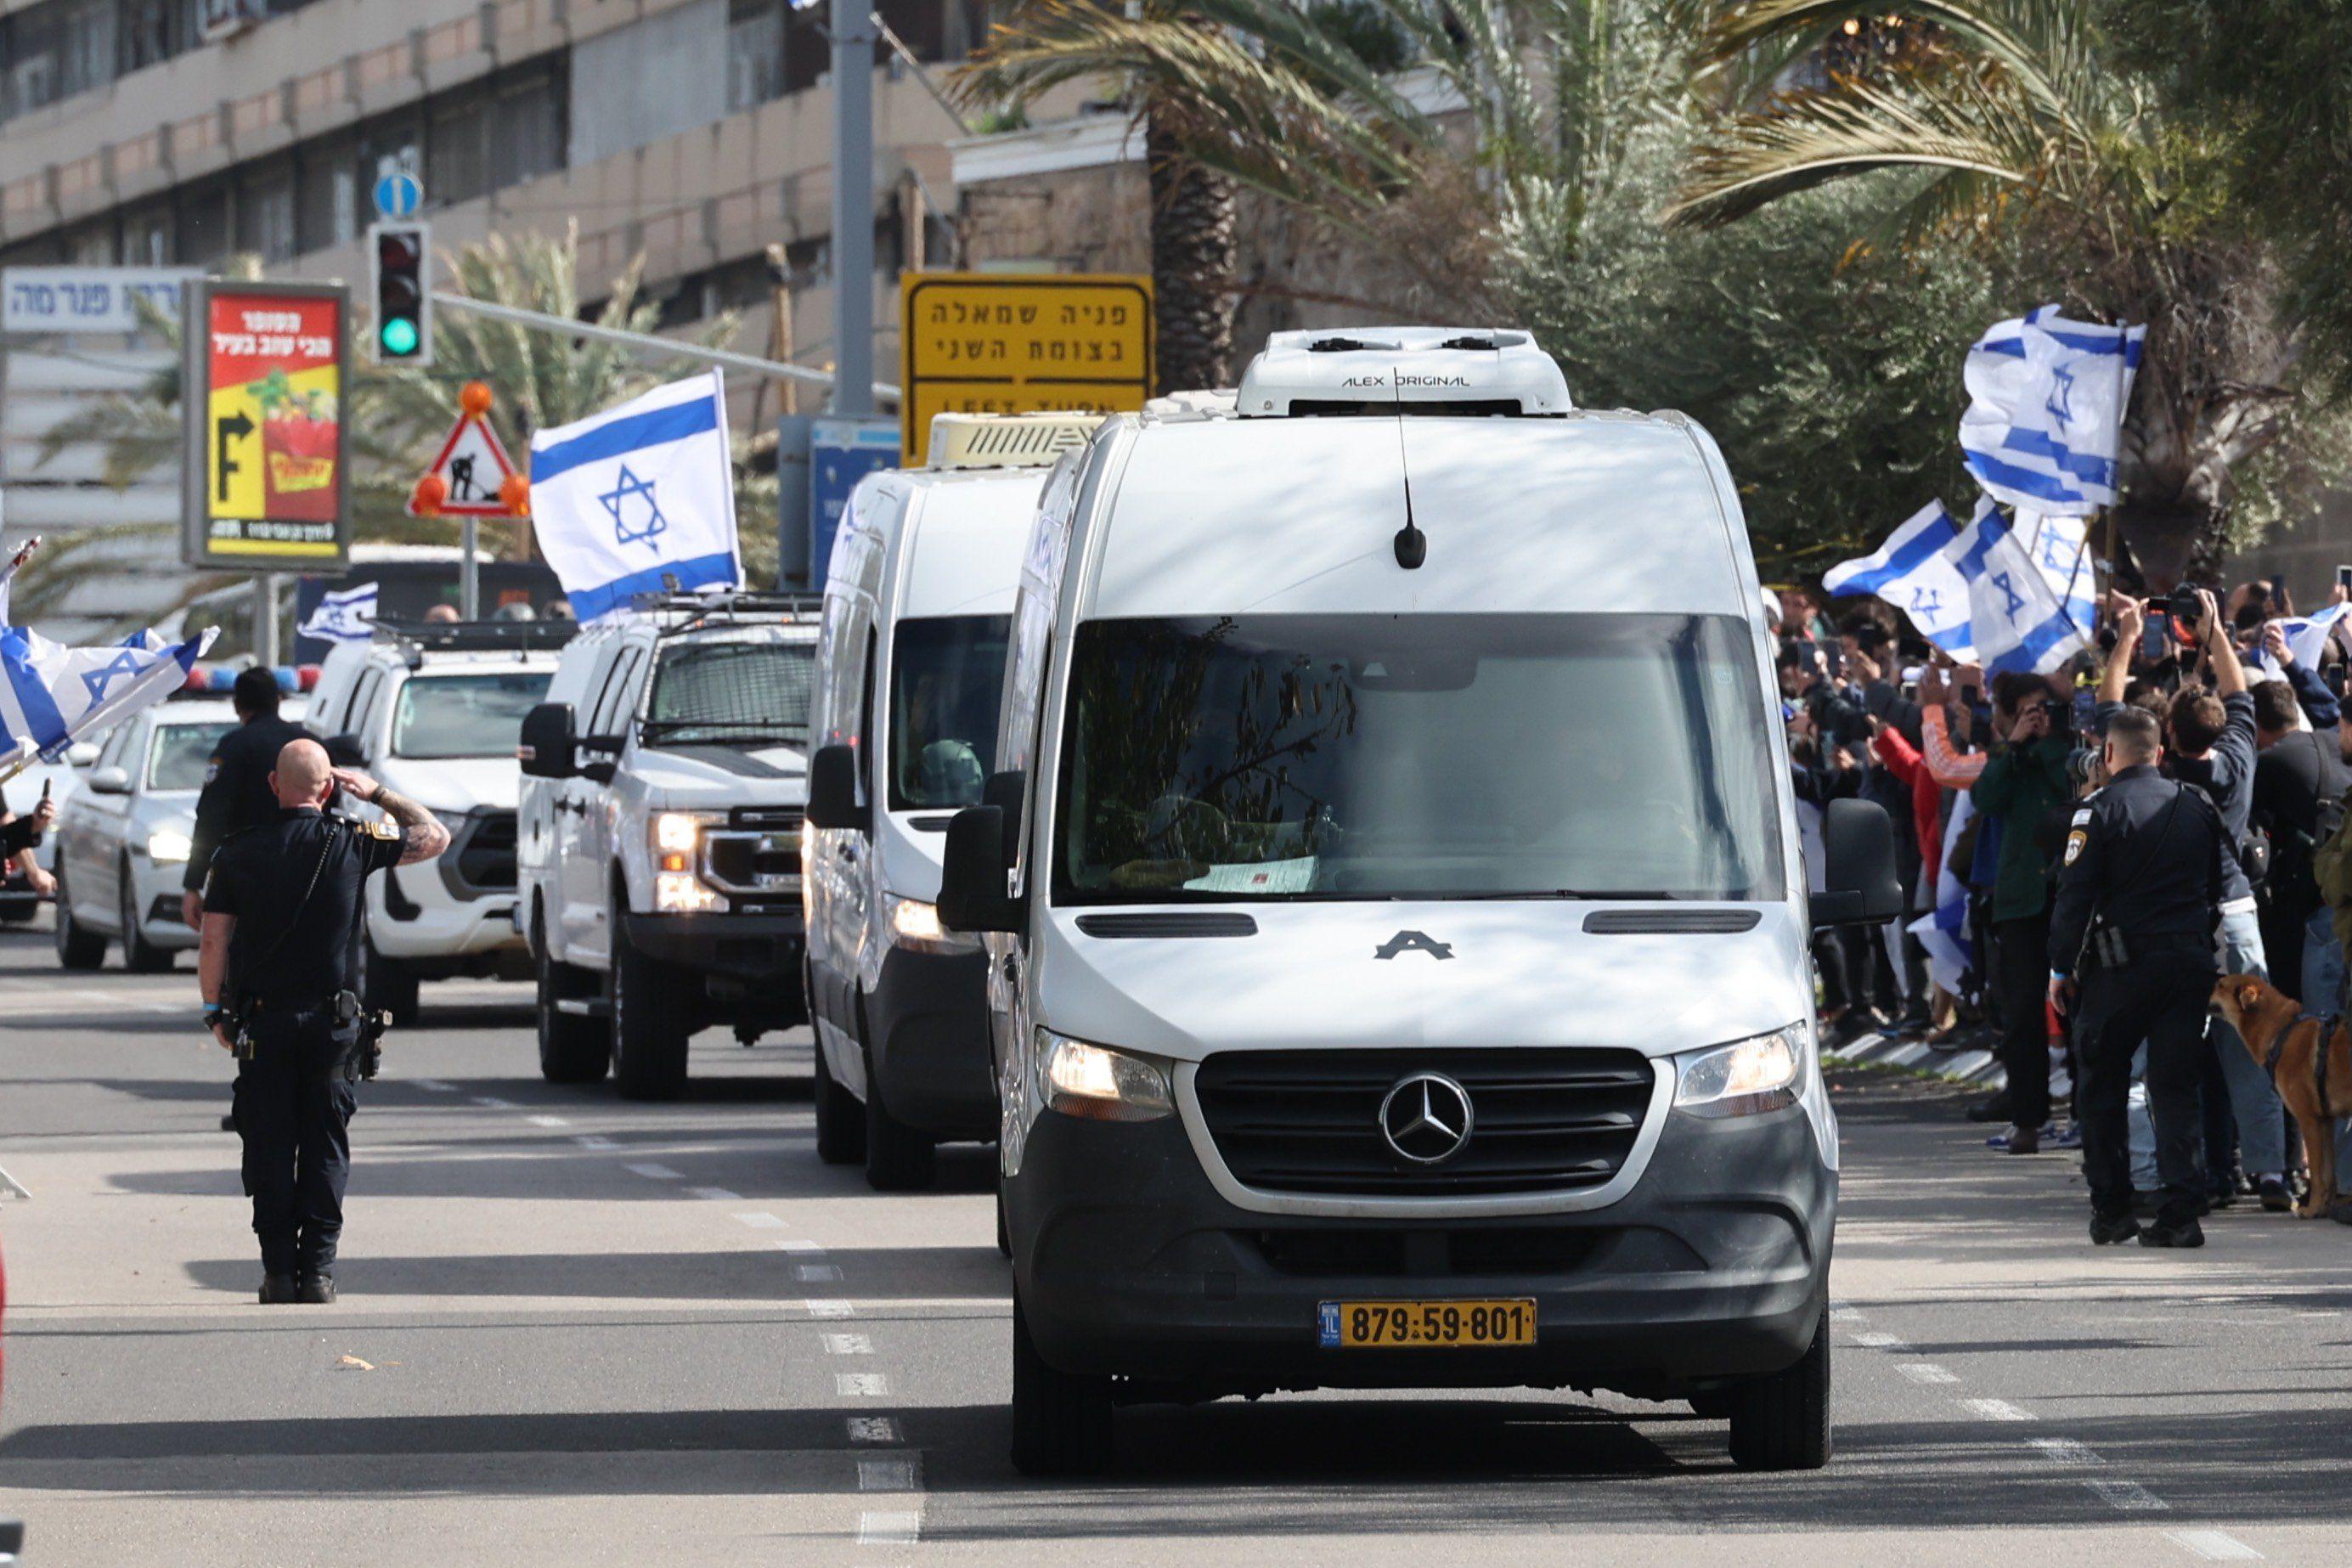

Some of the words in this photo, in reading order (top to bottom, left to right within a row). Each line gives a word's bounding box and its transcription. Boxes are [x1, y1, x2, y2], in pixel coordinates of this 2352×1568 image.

[931, 302, 1038, 324] שמאלה
[1061, 304, 1127, 324] פניה
[936, 339, 1007, 360] השני
[1028, 340, 1123, 362] בצומת
[1341, 375, 1385, 387] ALEX
[1395, 375, 1471, 387] ORIGINAL
[1324, 1317, 1338, 1334] IL
